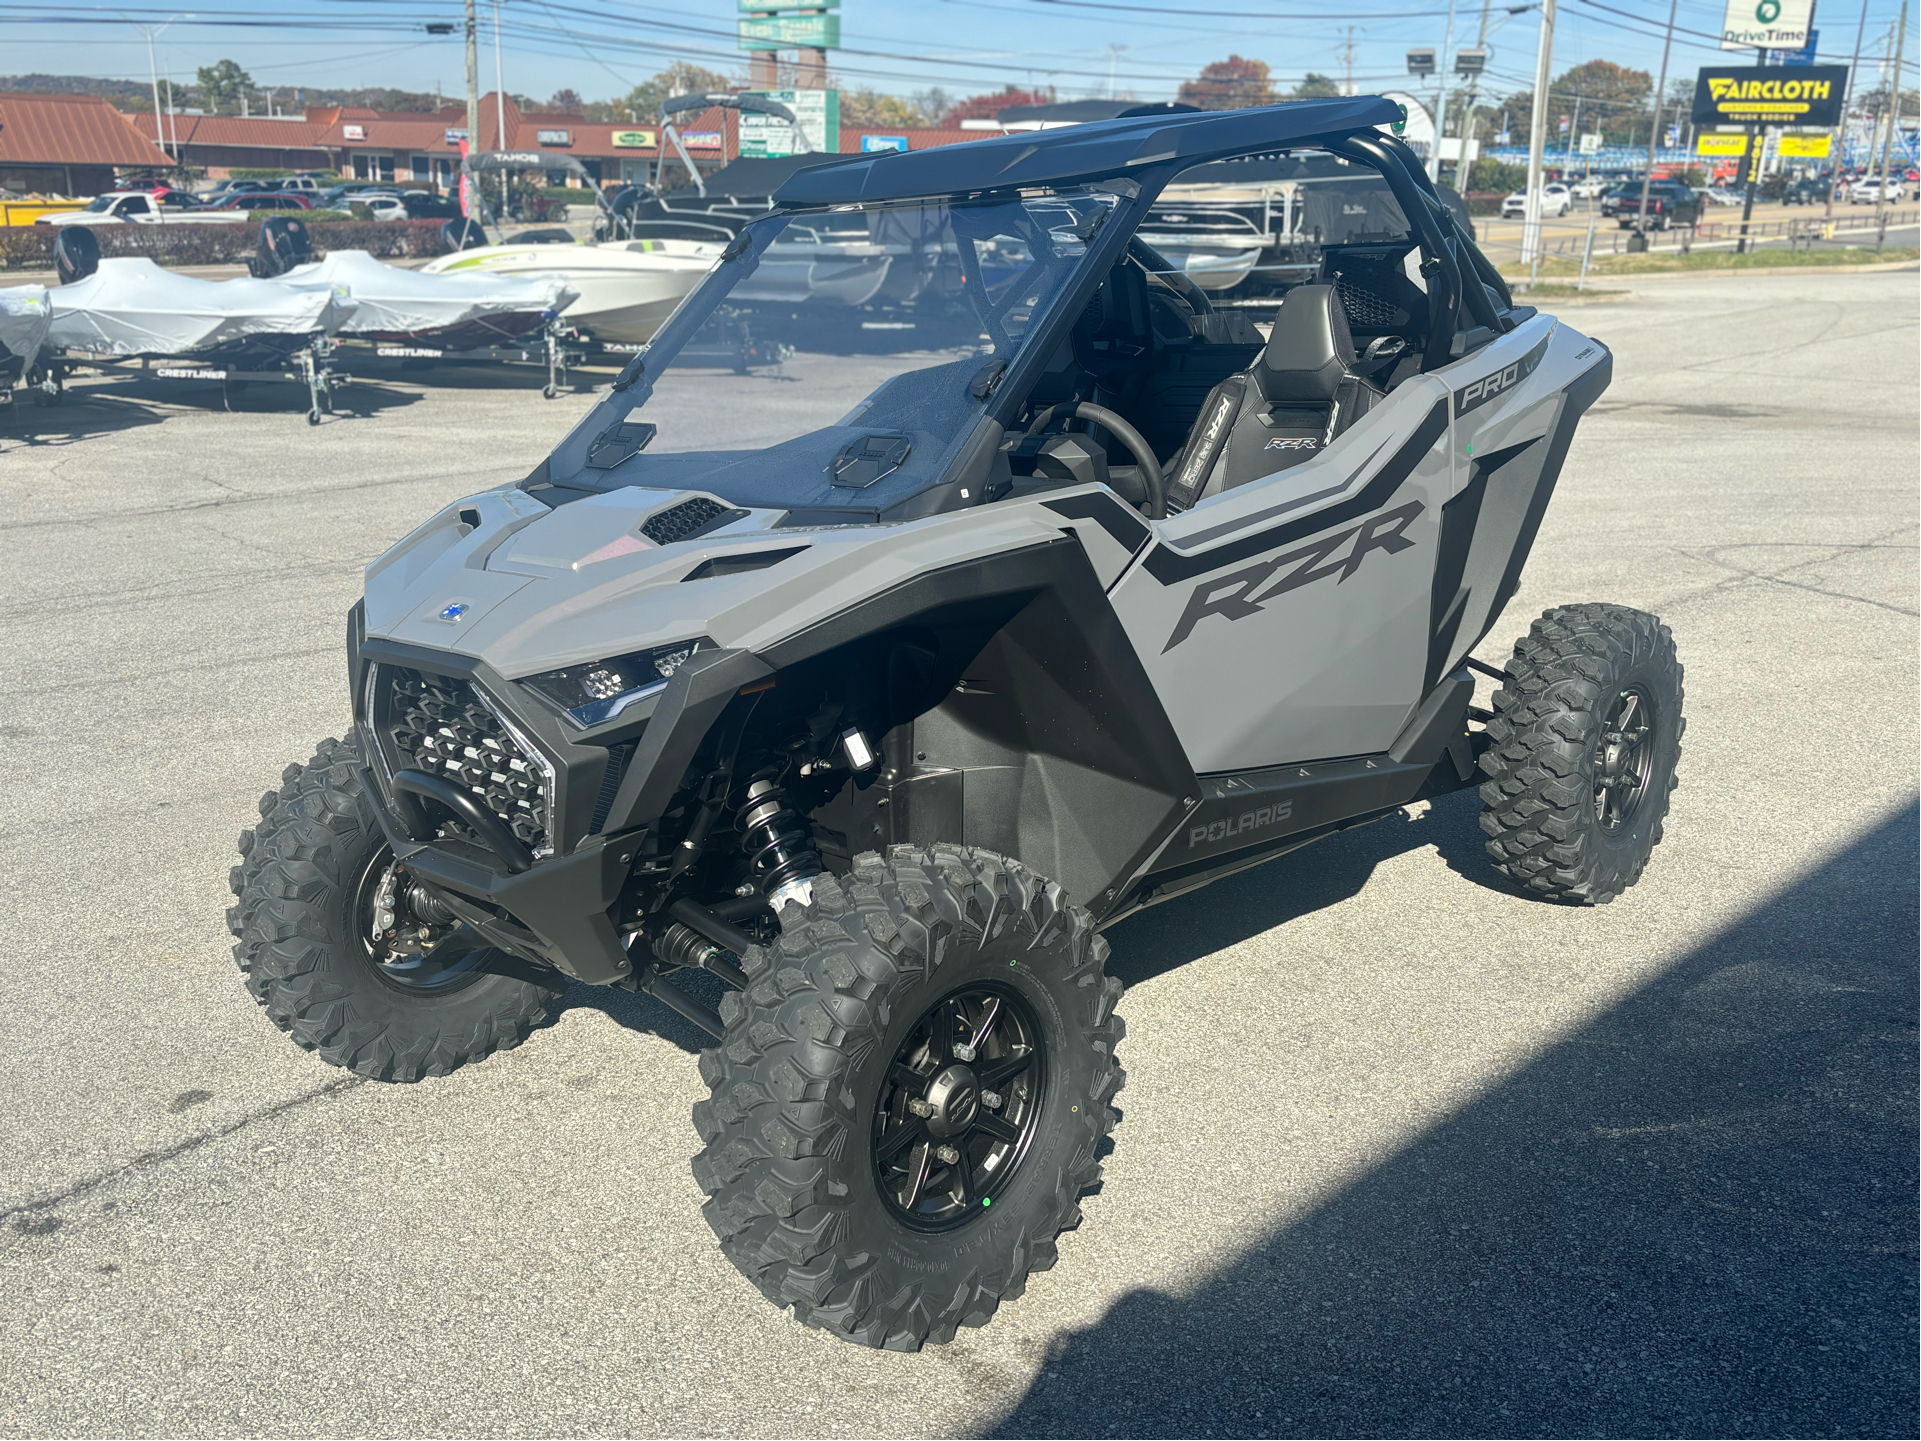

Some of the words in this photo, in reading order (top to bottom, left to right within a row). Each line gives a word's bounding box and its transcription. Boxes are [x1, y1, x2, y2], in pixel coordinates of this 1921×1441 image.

[1723, 29, 1804, 43] DriveTime
[1708, 78, 1831, 101] FAIRCLOTH
[1761, 113, 1795, 121] BODIES
[377, 347, 443, 358] CRESTLINER
[603, 343, 647, 353] TAHO
[157, 368, 228, 380] CRESTLINER
[1461, 363, 1519, 410] PRO
[1207, 397, 1231, 439] RZR
[1264, 437, 1318, 450] RZR
[1160, 499, 1426, 655] RZR
[1188, 800, 1293, 850] POLARIS
